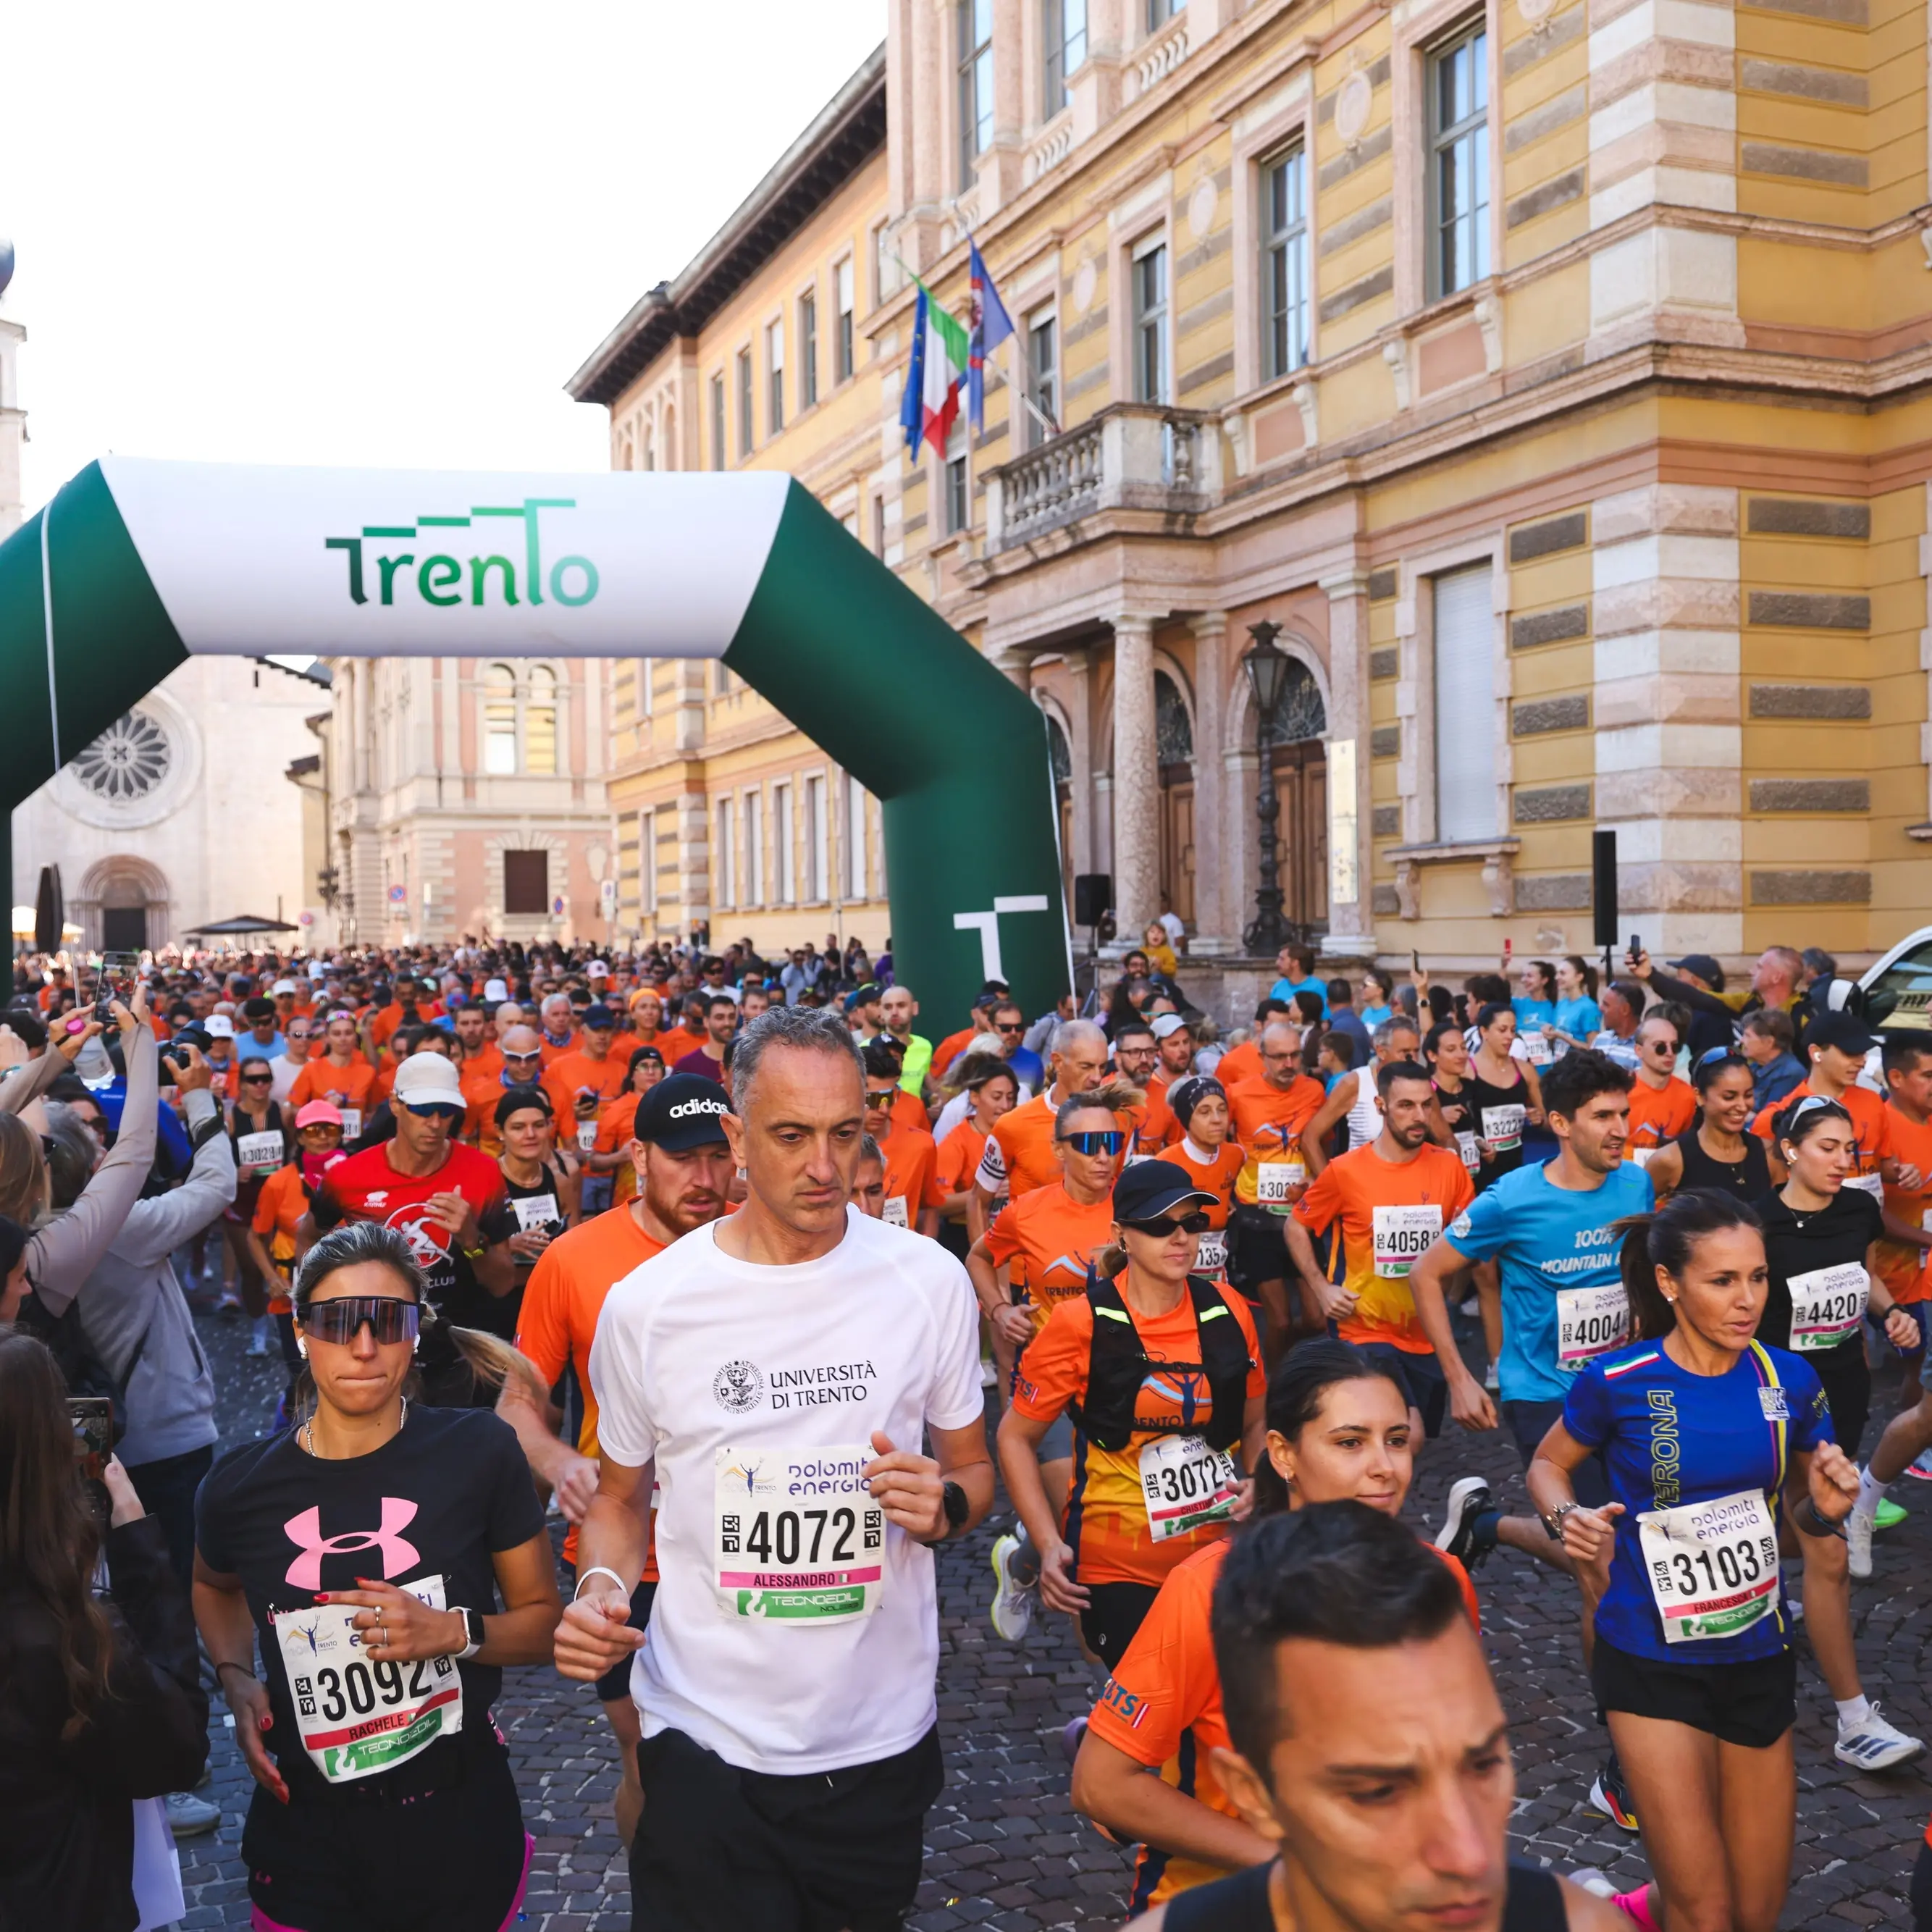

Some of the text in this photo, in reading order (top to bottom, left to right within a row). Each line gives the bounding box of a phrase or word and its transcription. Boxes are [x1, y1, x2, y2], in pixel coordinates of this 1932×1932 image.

[325, 498, 600, 608] Trento
[669, 1099, 729, 1118] adidas
[1267, 1182, 1297, 1198] 30
[1387, 1230, 1430, 1253] 4058
[1198, 1247, 1220, 1266] 135
[1540, 1254, 1612, 1274] MOUNTAIN
[1044, 1286, 1085, 1296] TRENTO
[1807, 1293, 1857, 1324] 4420
[1575, 1311, 1621, 1345] 4004
[770, 1360, 878, 1388] UNIVERSITÀ
[771, 1385, 868, 1410] DI TRENTO
[1183, 1440, 1206, 1455] ener
[1162, 1454, 1223, 1502] 3072
[747, 1507, 856, 1565] 4072
[753, 1573, 836, 1587] ALESSANDRO
[1673, 1539, 1760, 1597] 3103
[771, 1592, 860, 1607] TECNOEDIL
[317, 1660, 432, 1722] 3092
[349, 1713, 405, 1741] RACHELE
[358, 1718, 437, 1756] TECNOEDIL
